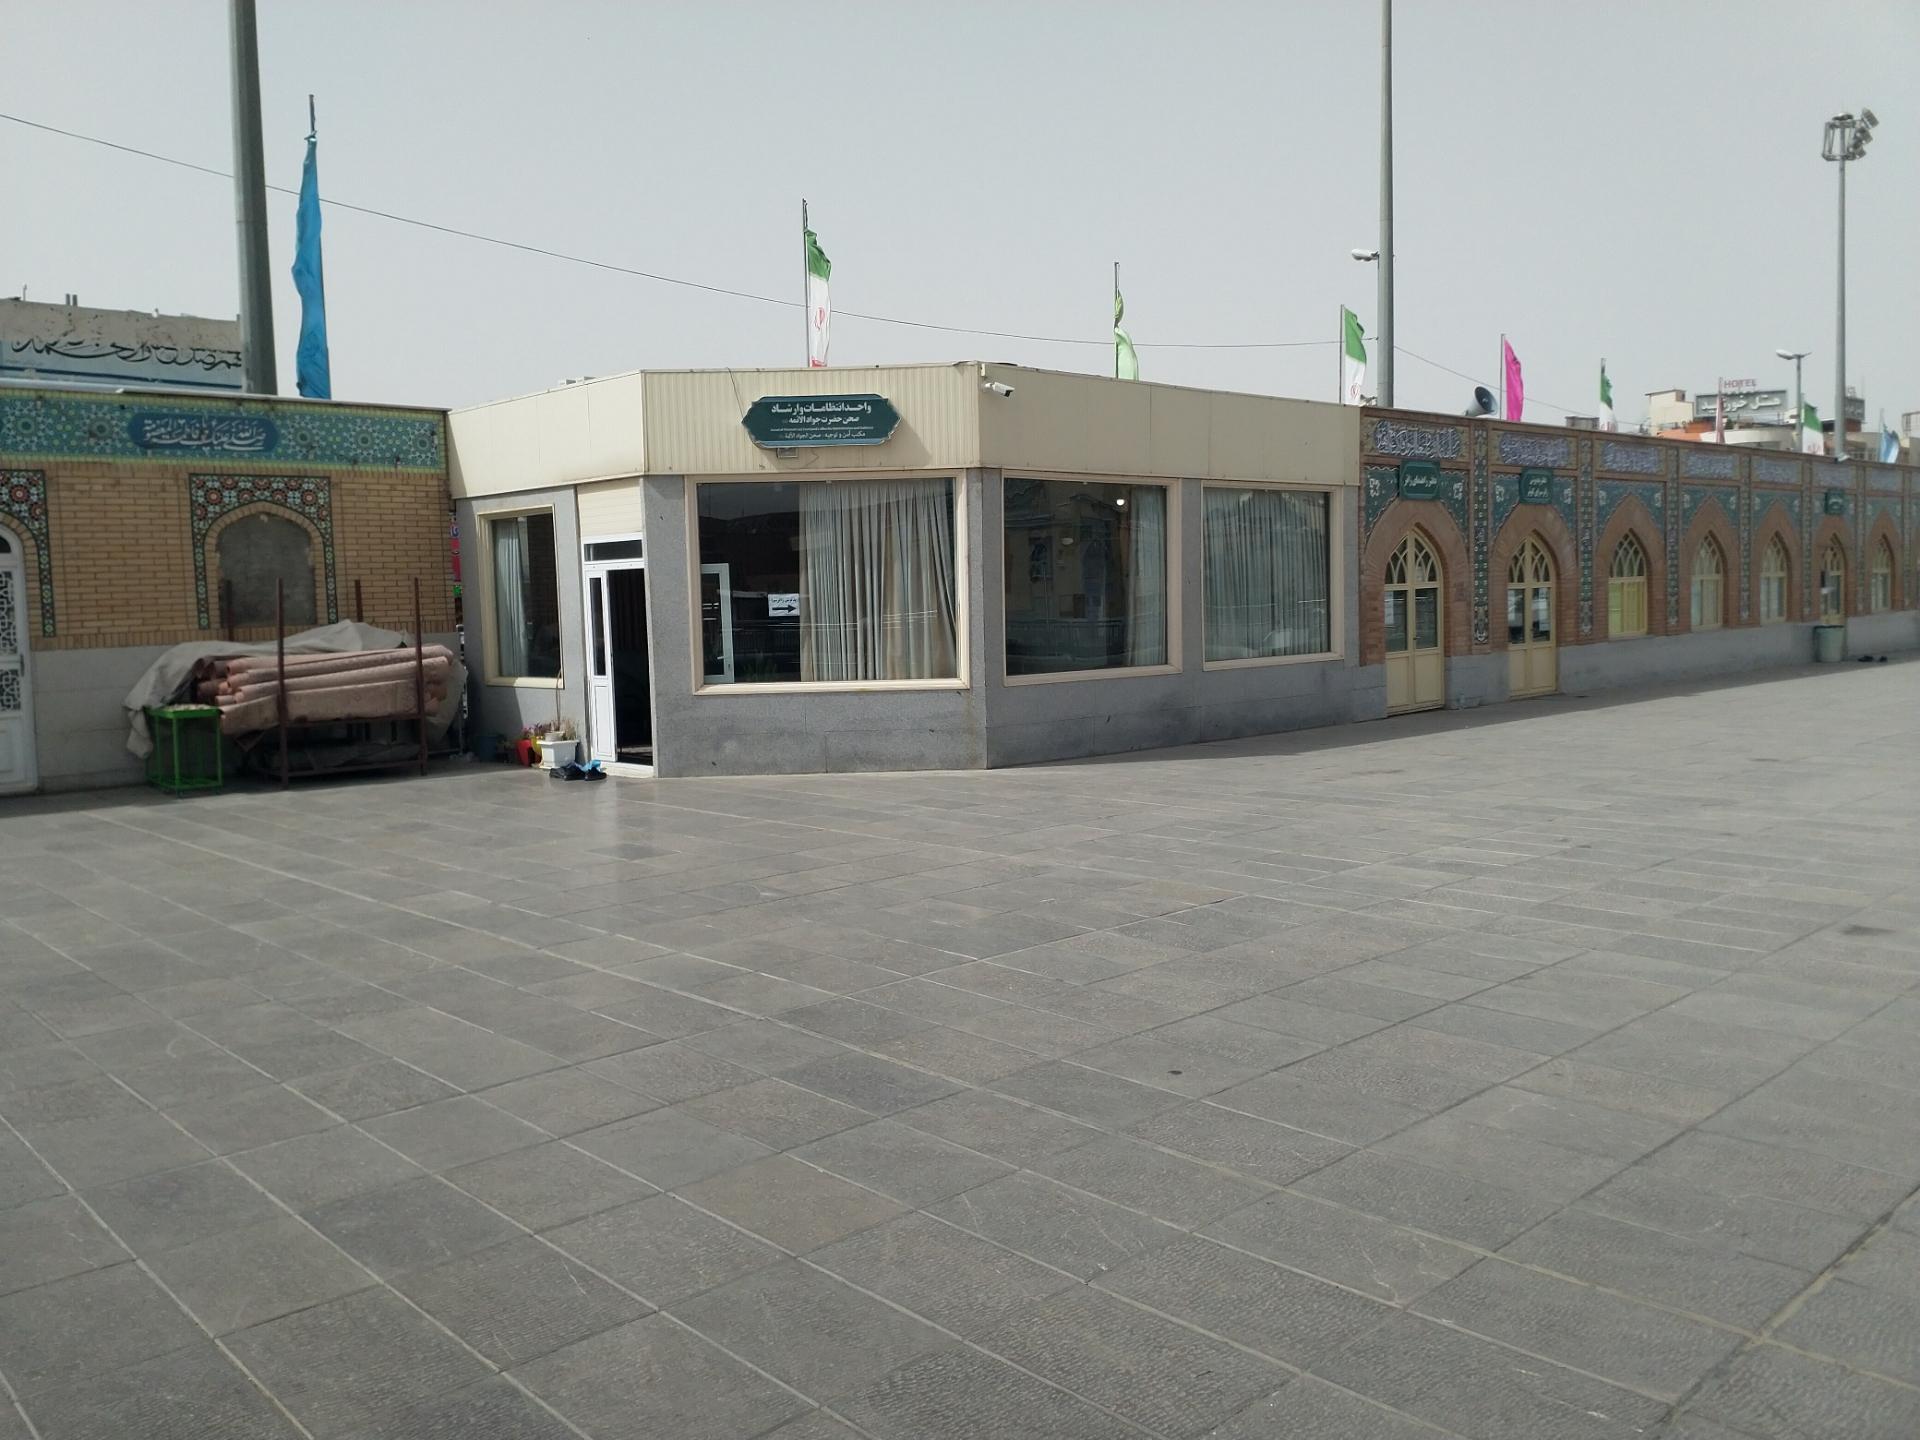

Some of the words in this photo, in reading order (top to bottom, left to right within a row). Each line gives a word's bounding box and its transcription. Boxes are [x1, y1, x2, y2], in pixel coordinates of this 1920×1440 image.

[1724, 379, 1756, 388] HOTEL
[803, 401, 845, 412] انتظامات
[1751, 394, 1781, 410] هتل
[844, 401, 872, 414] واحد
[806, 415, 821, 425] جواد
[821, 416, 842, 425] حضرت
[842, 416, 860, 425] صحن
